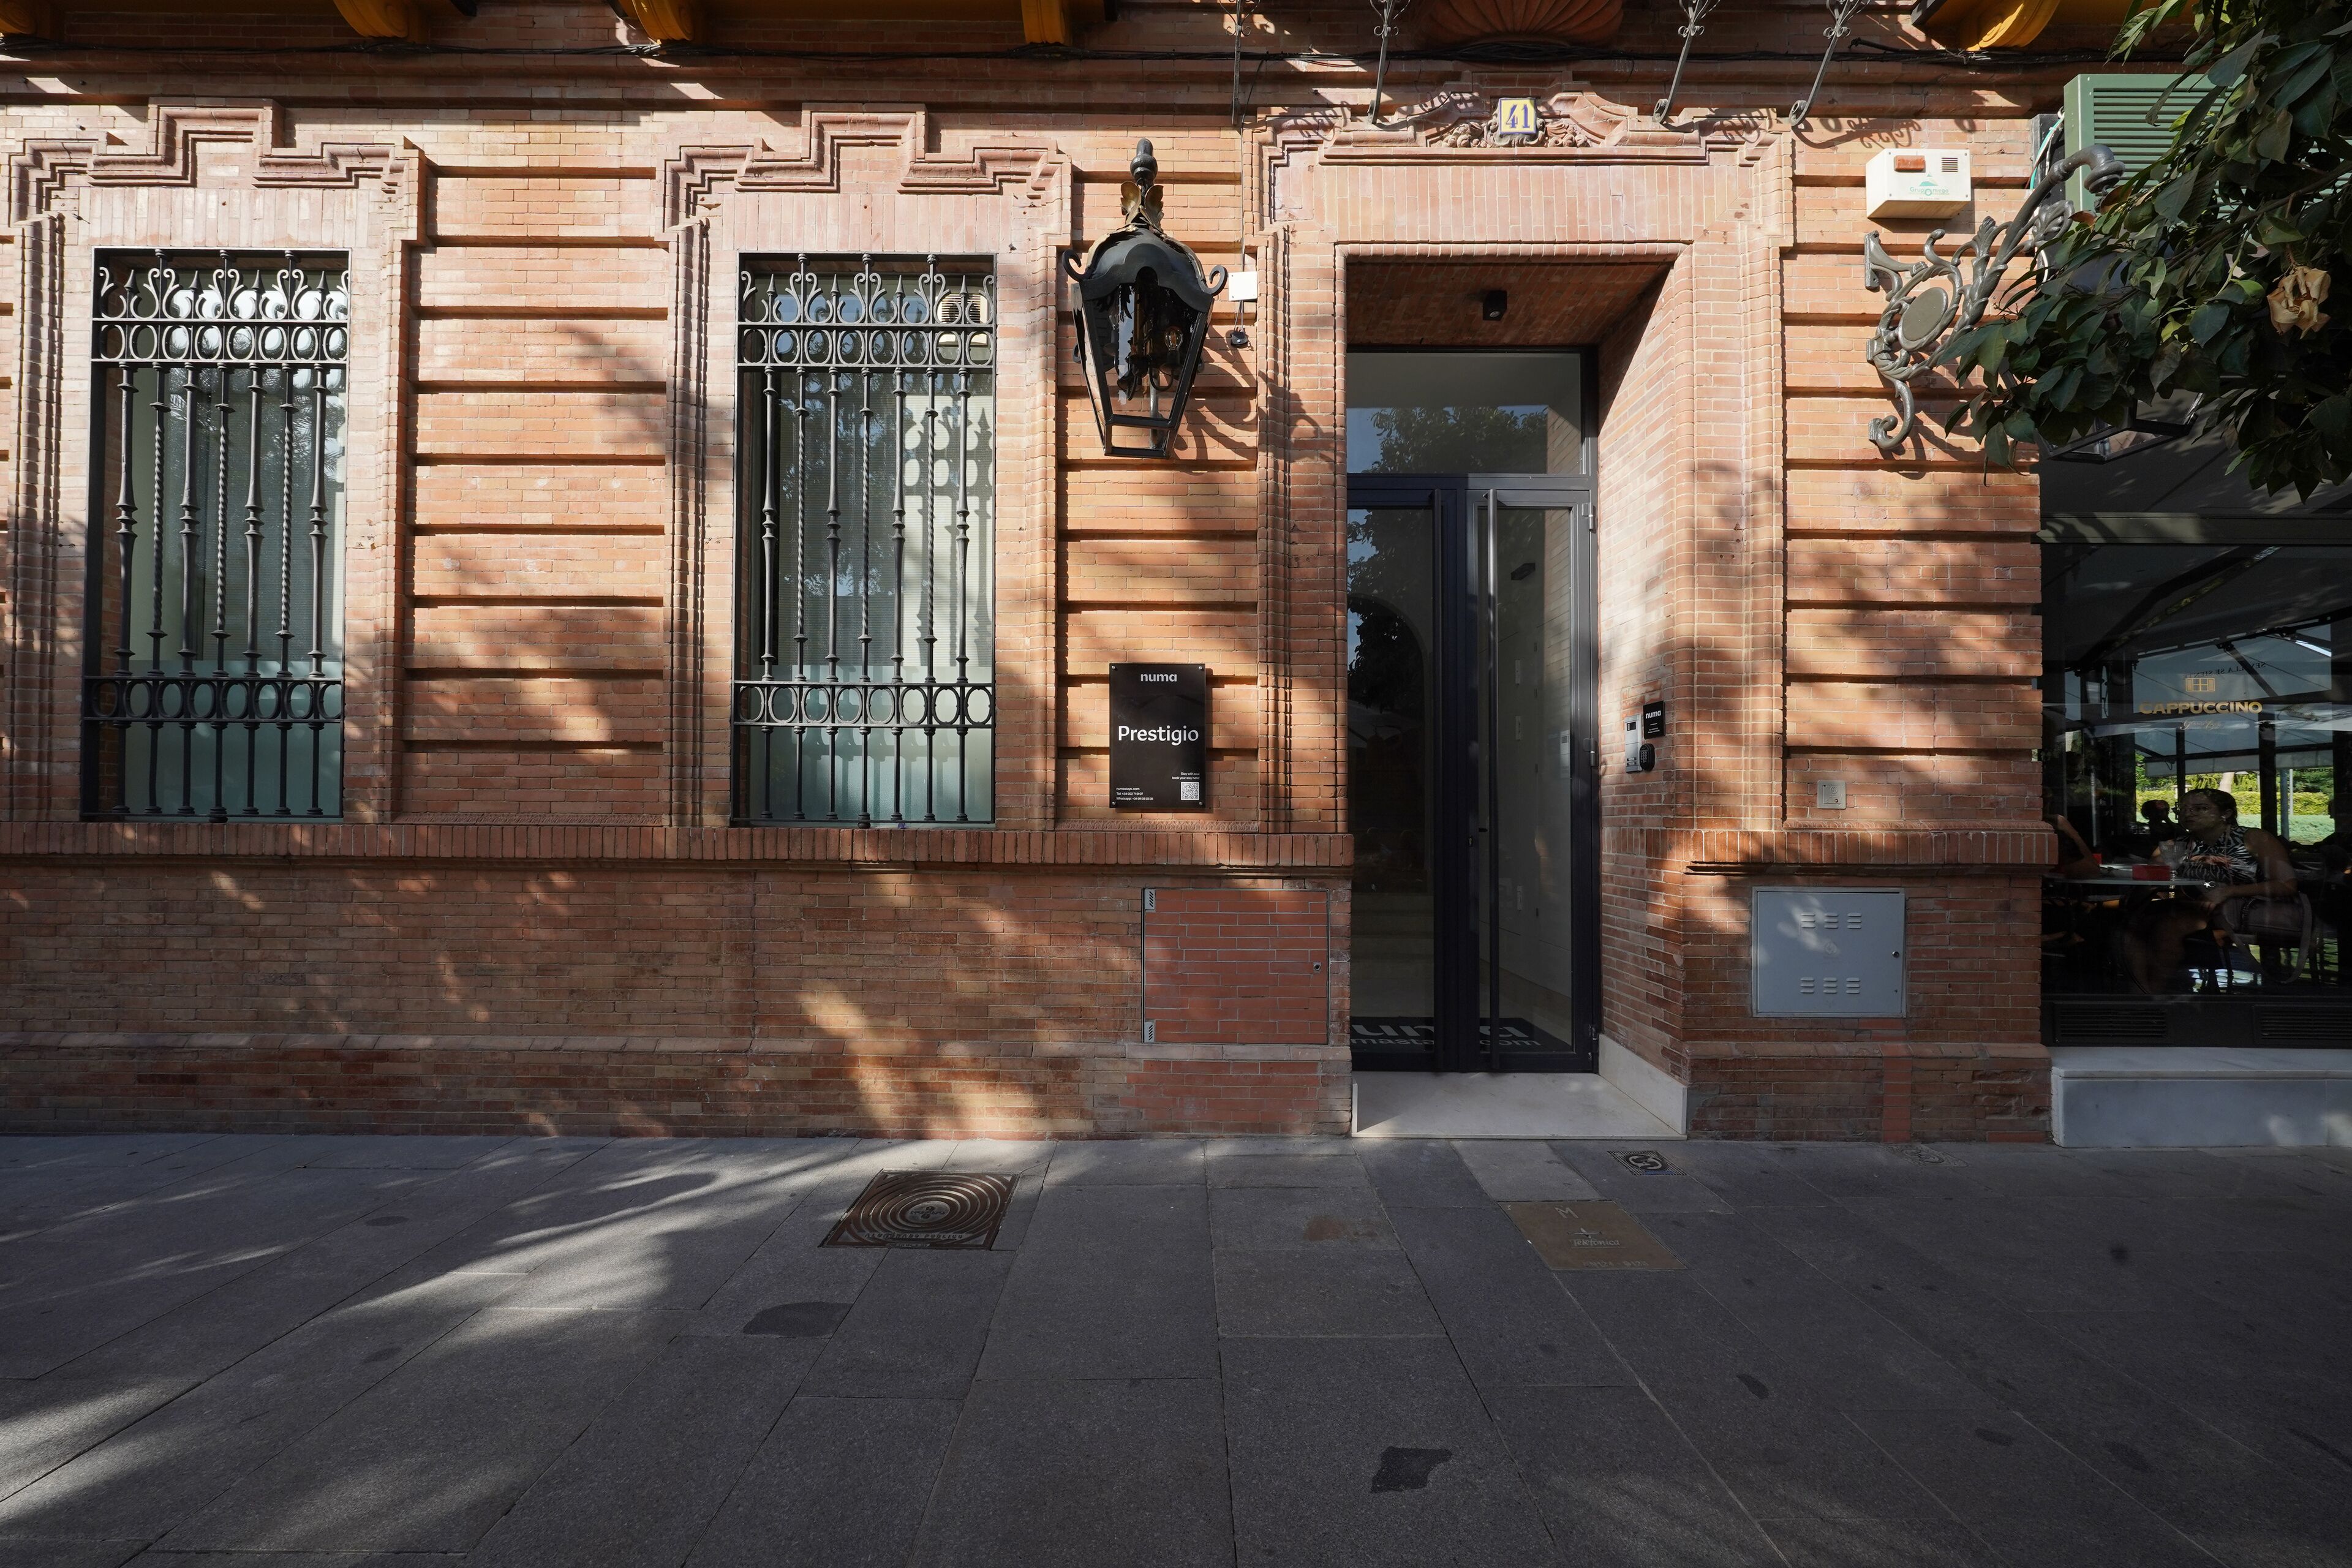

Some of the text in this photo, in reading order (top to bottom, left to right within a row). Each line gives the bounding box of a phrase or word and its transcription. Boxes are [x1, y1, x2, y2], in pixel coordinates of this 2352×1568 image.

[1506, 104, 1530, 128] 41
[1646, 710, 1661, 719] numa
[2139, 701, 2263, 714] CAPPUCCINO
[1118, 725, 1199, 746] Prestigio
